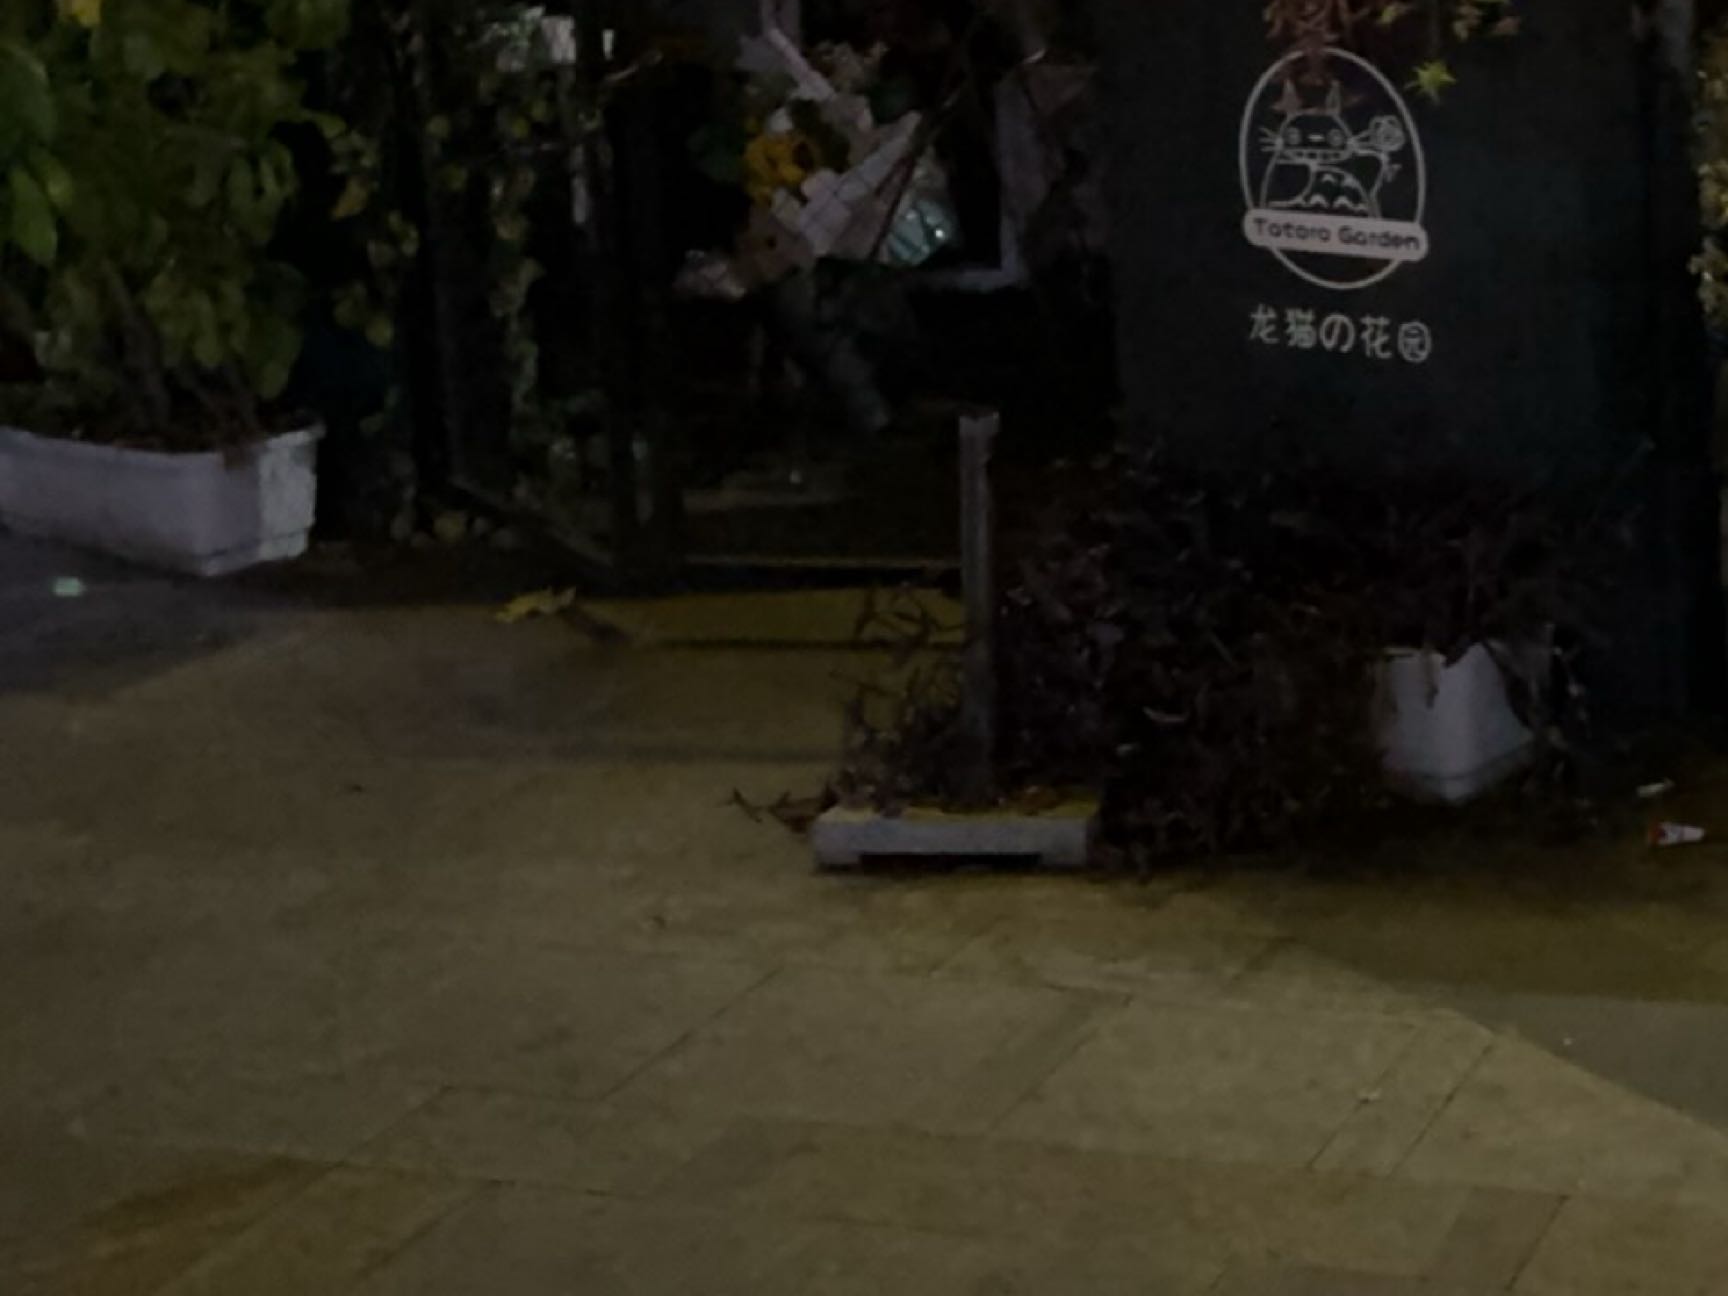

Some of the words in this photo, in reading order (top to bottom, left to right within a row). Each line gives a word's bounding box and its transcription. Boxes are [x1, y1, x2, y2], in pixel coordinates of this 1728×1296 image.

[1253, 218, 1331, 242] Totoro
[1338, 225, 1420, 250] Garden
[1249, 303, 1432, 363] 龙猫の花园
